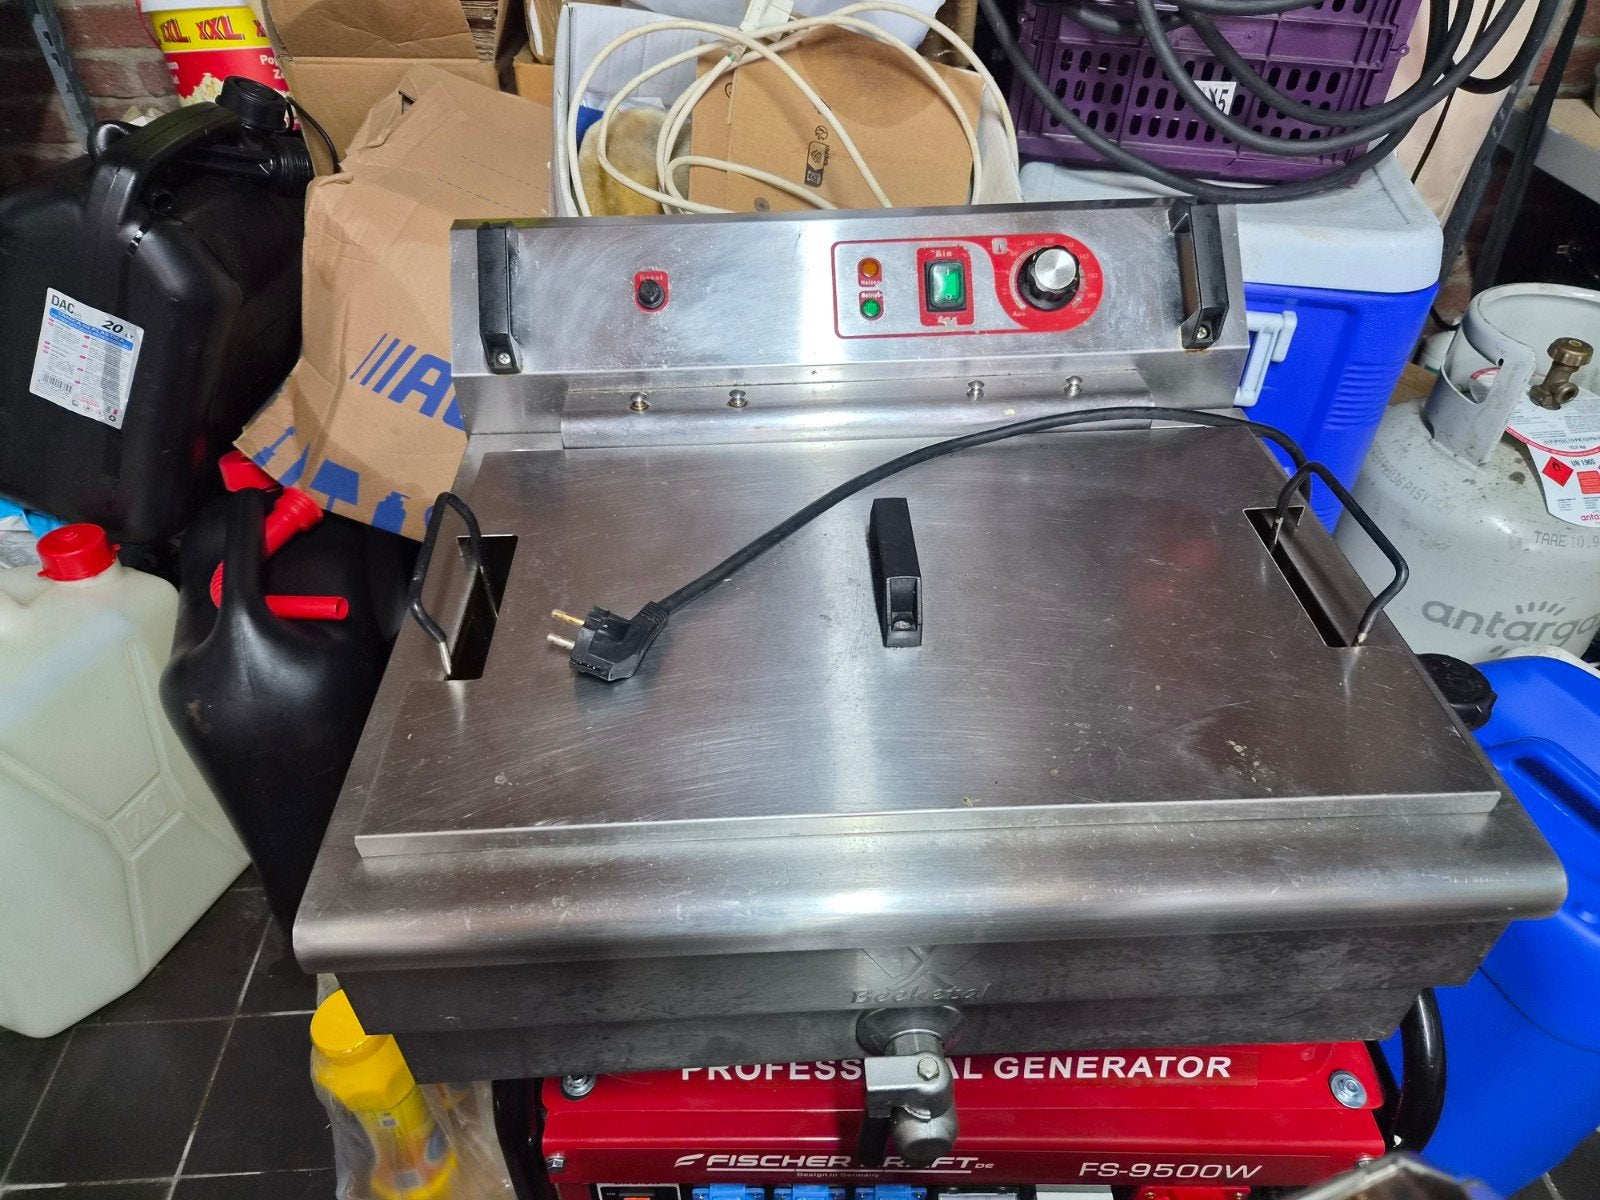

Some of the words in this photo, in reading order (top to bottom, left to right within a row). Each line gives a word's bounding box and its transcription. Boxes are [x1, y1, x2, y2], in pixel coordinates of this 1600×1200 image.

[195, 15, 246, 40] XXL
[51, 294, 75, 315] DAC
[102, 320, 124, 334] 20
[1535, 530, 1567, 547] TARE
[993, 1055, 1233, 1080] GENERATOR
[706, 1154, 852, 1168] FISCHER
[1078, 1162, 1263, 1179] FS-9500W
